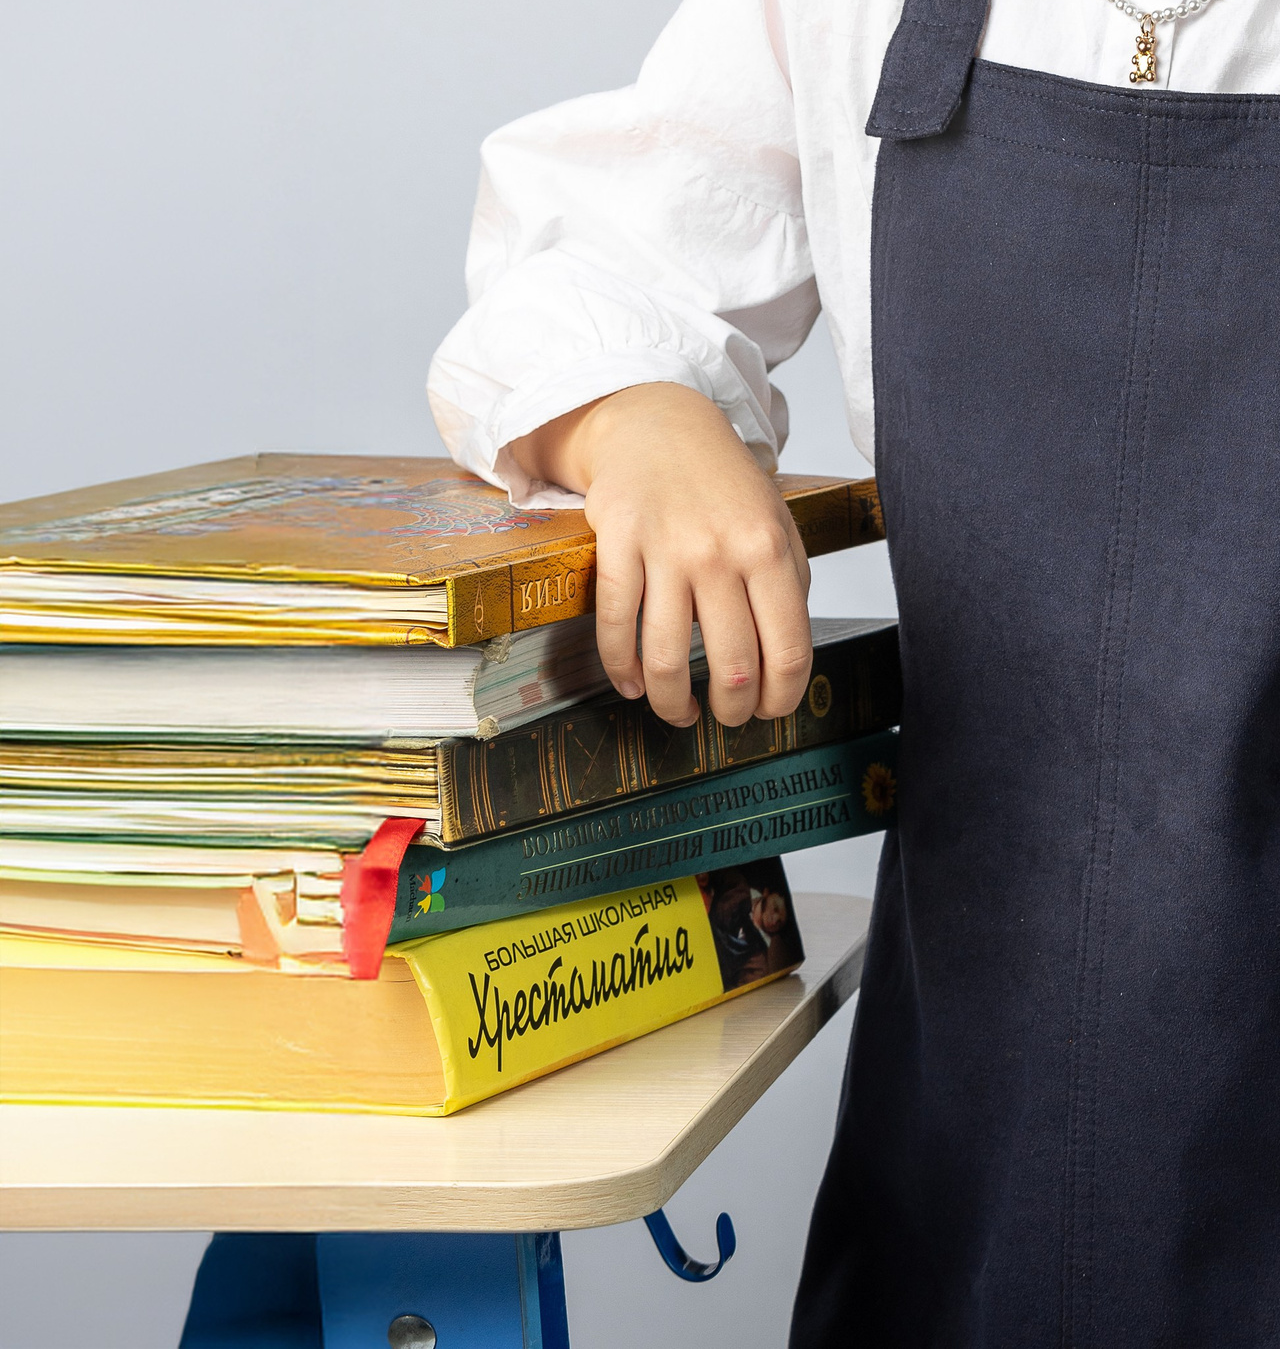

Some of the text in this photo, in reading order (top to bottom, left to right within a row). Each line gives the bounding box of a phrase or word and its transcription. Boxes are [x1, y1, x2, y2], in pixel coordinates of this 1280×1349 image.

[516, 800, 851, 900] ЭНЦИКЛОПЕДИЯ ШКОЛЬНИКА
[521, 763, 845, 860] БОЛЬШАЯ ИЛЛЮСТРИРОВАННАЯ
[405, 873, 417, 923] Machaon
[483, 884, 678, 972] БОЛЬШАЯ ШКОЛЬНАЯ
[468, 923, 694, 1073] Хрестоматия
